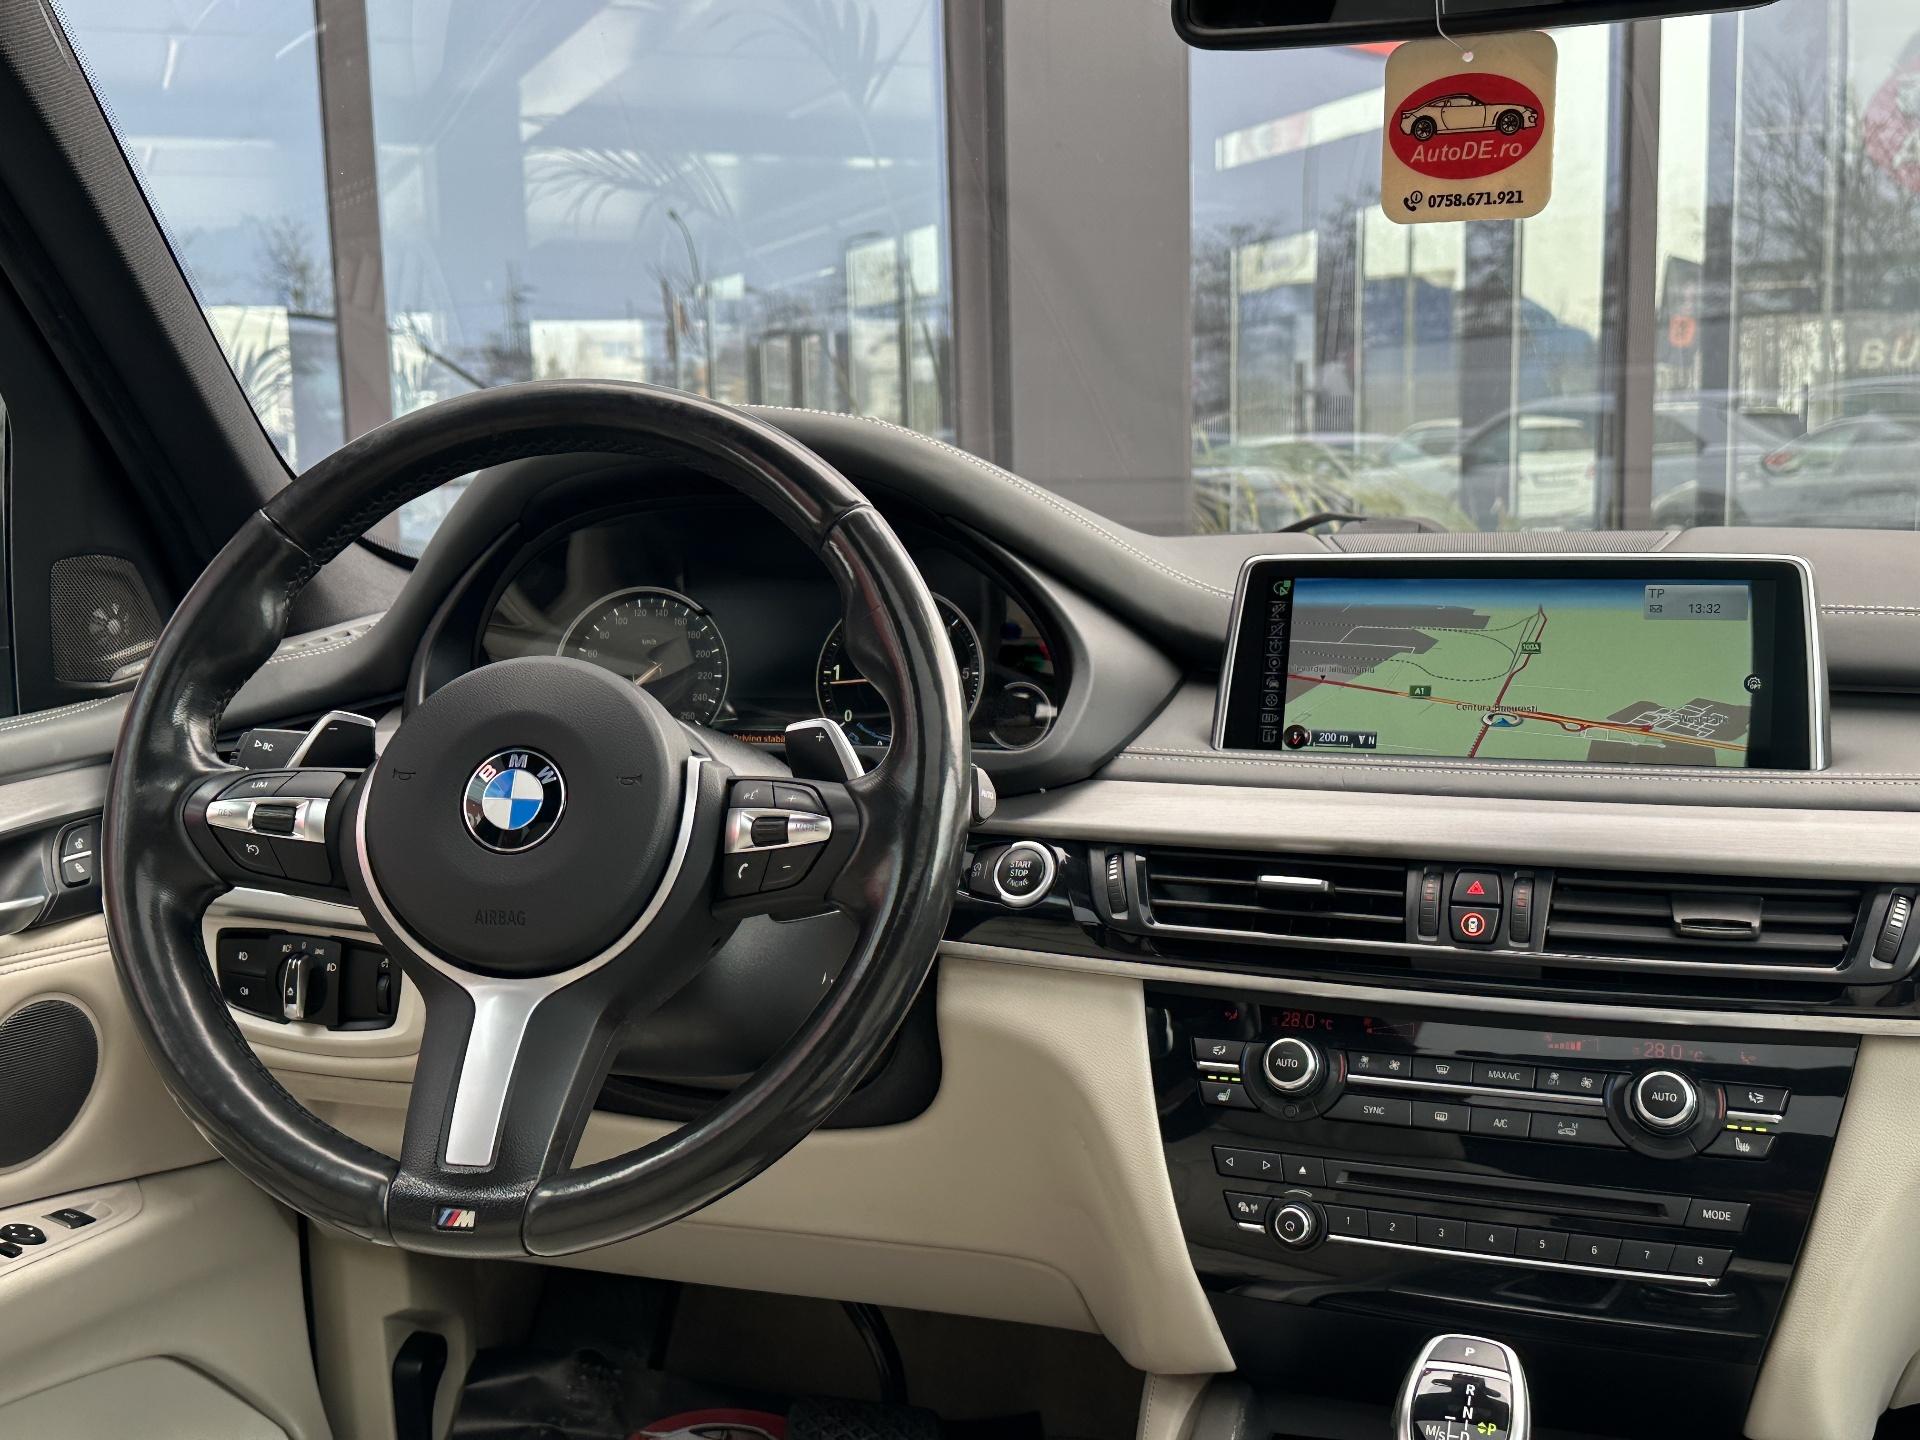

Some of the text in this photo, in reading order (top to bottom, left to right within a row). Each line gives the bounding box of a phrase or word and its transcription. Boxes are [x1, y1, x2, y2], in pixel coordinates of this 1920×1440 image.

[1410, 140, 1522, 163] AutoDE.ro
[1428, 190, 1523, 208] 0758.671.921
[1648, 588, 1664, 598] TP
[1688, 604, 1720, 614] 13:32
[833, 664, 840, 680] 1
[962, 668, 969, 679] 5
[1414, 687, 1425, 695] A1
[1456, 704, 1490, 712] Centura
[681, 712, 695, 720] 260
[844, 709, 852, 722] 0
[1319, 733, 1337, 742] 200
[478, 753, 556, 785] BMW
[1010, 860, 1032, 869] START
[1010, 869, 1028, 877] STOP
[474, 909, 526, 926] AIRBAG
[1281, 1011, 1315, 1029] 28.0
[1643, 1042, 1682, 1060] 28.0
[1276, 1058, 1298, 1068] AUTO
[1488, 1070, 1520, 1081] MAX A/C
[1652, 1091, 1678, 1102] AUTO
[1363, 1106, 1384, 1115] SYNC
[1493, 1119, 1507, 1128] A/C
[1346, 1216, 1350, 1225] 1
[1702, 1210, 1732, 1221] MODE
[1390, 1223, 1396, 1232] 2
[1438, 1228, 1444, 1237] 3
[1488, 1234, 1494, 1243] 4
[1539, 1240, 1545, 1248] 5
[1592, 1245, 1597, 1255] 6
[1645, 1250, 1650, 1260] 7
[1697, 1256, 1703, 1265] 8
[1465, 1347, 1476, 1356] P
[1466, 1384, 1476, 1396] R
[1462, 1406, 1473, 1419] N
